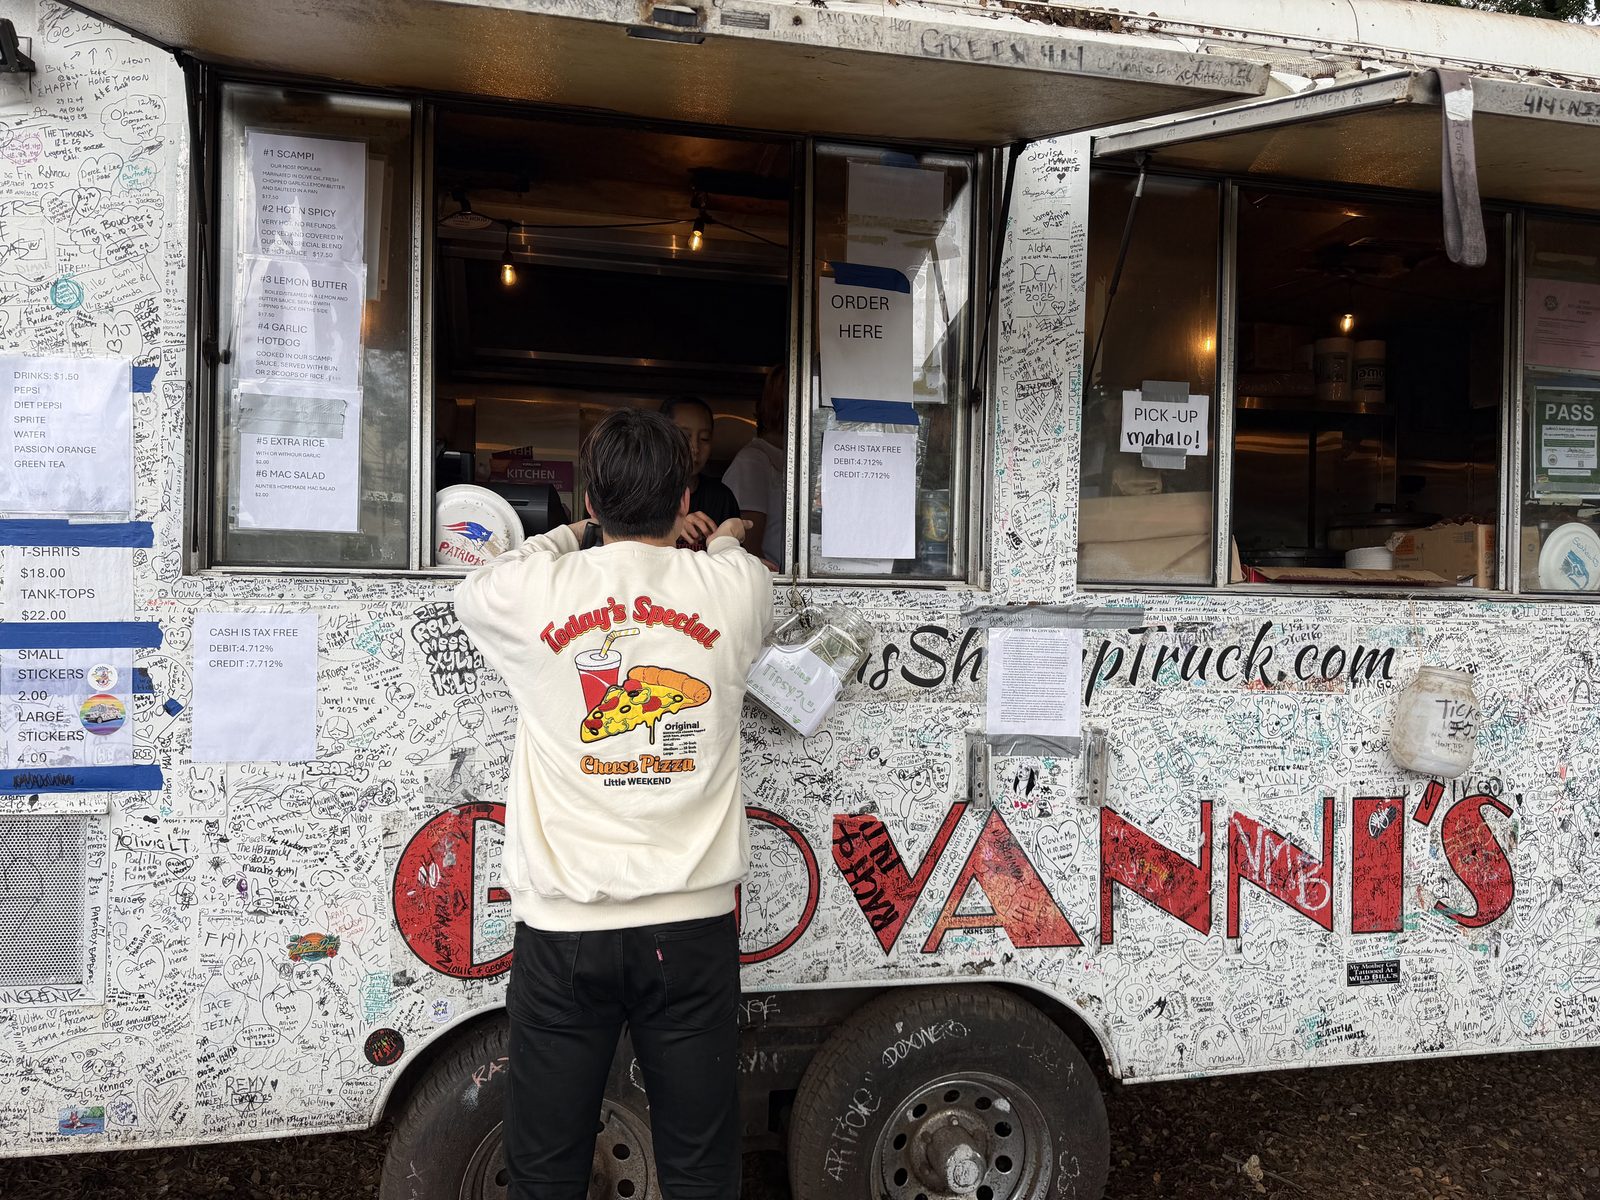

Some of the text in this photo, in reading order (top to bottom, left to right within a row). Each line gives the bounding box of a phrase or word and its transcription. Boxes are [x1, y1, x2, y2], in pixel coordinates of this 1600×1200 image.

[263, 149, 314, 160] #1 SCAMPI
[262, 205, 274, 213] #2
[276, 206, 296, 214] HOT
[308, 207, 336, 218] SPICY
[262, 218, 278, 226] VERY
[289, 230, 304, 238] AND
[305, 232, 335, 240] COVERED
[322, 242, 342, 250] BLEND
[286, 248, 308, 256] SAUCE
[260, 276, 348, 290] #3 LEMON BUTTER
[832, 295, 890, 310] ORDER
[1025, 294, 1055, 302] 2025
[258, 322, 308, 334] #4 GARLIC
[840, 324, 883, 339] HERE
[257, 336, 300, 347] HOTDOG
[308, 354, 332, 362] SCAMPI
[280, 362, 306, 370] SERVED
[324, 364, 338, 372] BUN
[14, 372, 79, 380] DRINKS: $1.50
[271, 370, 298, 378] SCOOPS
[14, 386, 40, 394] PEPSI
[14, 401, 35, 409] DIET
[1545, 404, 1594, 421] PASS
[14, 416, 46, 424] SPRITE
[256, 437, 325, 448] #5 EXTRA RICE
[1127, 429, 1200, 449] mahalo!
[14, 446, 96, 454] PASSION ORANGE
[834, 444, 856, 452] CASH
[882, 446, 902, 454] FREE
[14, 460, 66, 468] GREEN TEA
[834, 458, 883, 466] DEBIT:4.712%
[256, 470, 326, 480] #6 MAC SALAD
[507, 468, 555, 480] KITCHEN
[834, 470, 860, 478] CREDIT
[20, 546, 80, 557] T-SHRITS
[20, 567, 66, 578] $18.00
[20, 588, 96, 599] TANK-TOPS
[21, 610, 66, 621] $22.00
[540, 597, 628, 655] Today's
[632, 596, 721, 650] Special
[209, 628, 298, 637] CASH IS TAX FREE
[209, 644, 274, 653] DEBIT:4.712%
[18, 650, 64, 660] SMALL
[209, 660, 244, 668] CREDIT
[18, 668, 84, 680] STICKERS
[18, 690, 48, 701] 2.00
[18, 711, 64, 722] LARGE
[664, 721, 700, 732] Original
[18, 730, 84, 742] STICKERS
[18, 752, 47, 763] 4.00
[580, 754, 696, 775] Cheese Pizza
[604, 777, 672, 787] Little WEEKEND
[1361, 962, 1384, 970] Mother
[1350, 974, 1370, 982] WILD
